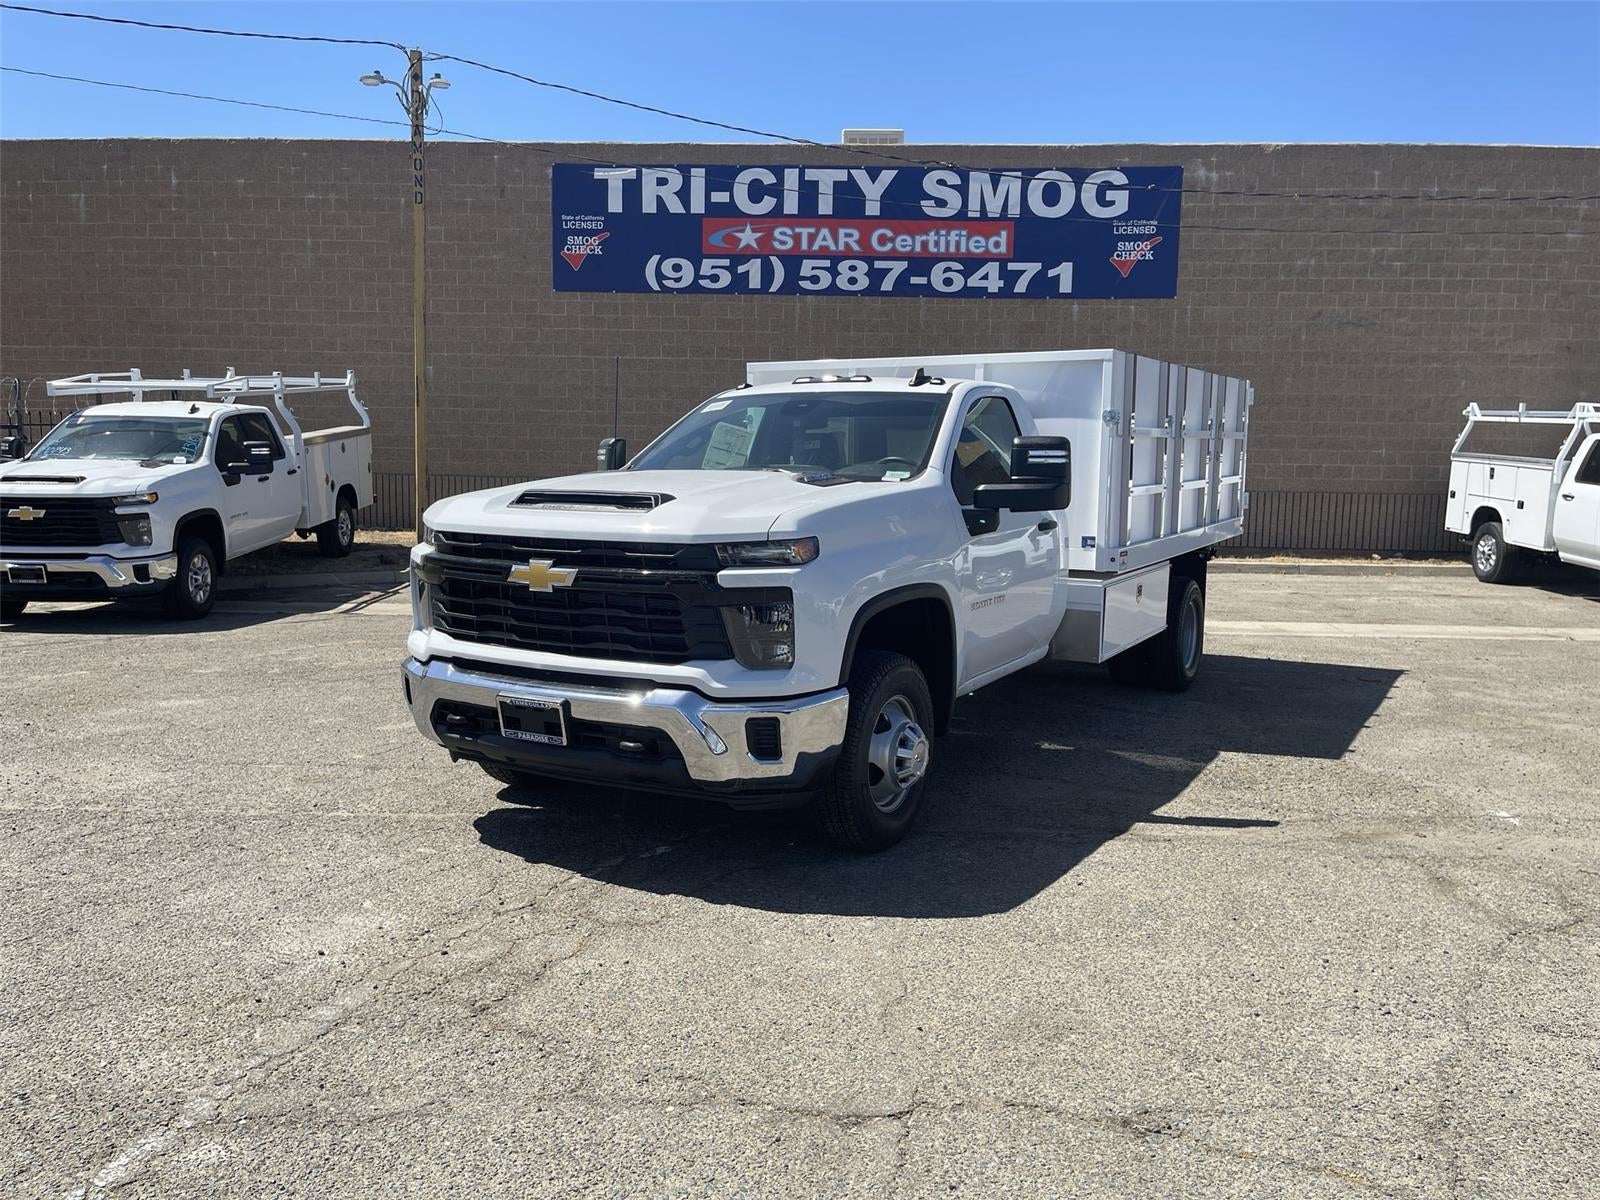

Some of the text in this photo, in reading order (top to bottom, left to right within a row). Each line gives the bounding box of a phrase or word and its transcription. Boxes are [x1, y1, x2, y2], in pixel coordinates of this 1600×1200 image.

[593, 167, 1129, 219] TRI-CITY SMOG
[562, 221, 604, 229] LICENSED
[1113, 226, 1157, 234] LICENSED
[567, 236, 599, 245] SMOG
[772, 227, 1007, 253] STAR Certified
[564, 245, 603, 255] CHECK
[1117, 241, 1151, 251] SMOG
[1113, 250, 1154, 260] CHECK
[645, 255, 1073, 293] (951) 587-6471
[518, 732, 549, 744] PARADISE
